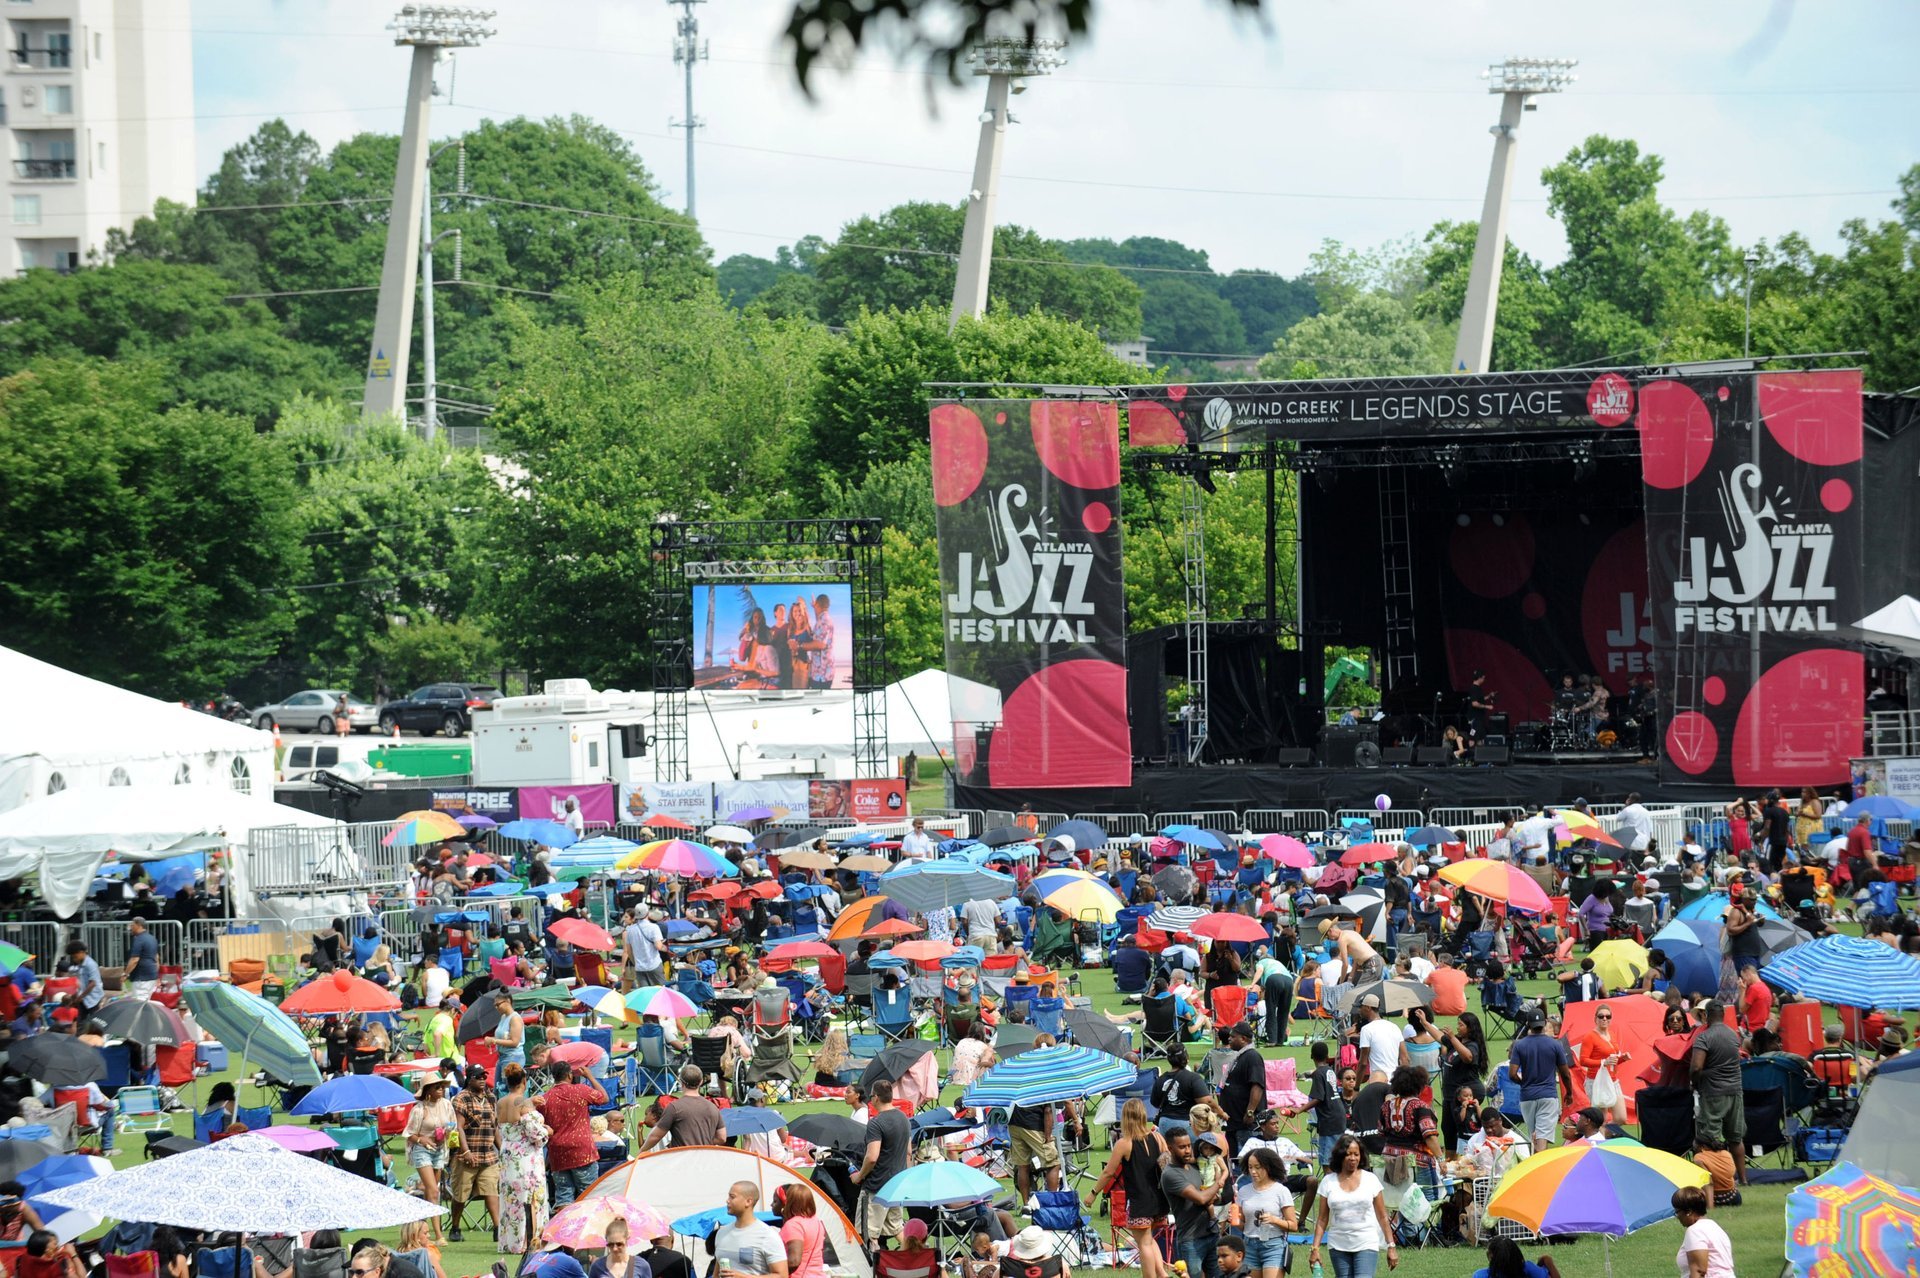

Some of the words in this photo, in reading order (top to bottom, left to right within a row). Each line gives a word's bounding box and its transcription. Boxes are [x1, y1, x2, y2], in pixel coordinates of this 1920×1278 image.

[1236, 402, 1282, 416] WIND
[1286, 400, 1340, 415] CREEK
[1350, 394, 1470, 421] LEGENDS
[1477, 391, 1563, 417] STAGE
[1772, 524, 1832, 535] ATLANTA
[1033, 542, 1093, 553] ATLANTA
[1675, 606, 1837, 632] FESTIVAL
[949, 618, 1096, 643] FESTIVAL
[1890, 774, 1909, 782] FREE
[660, 789, 674, 798] EAT
[677, 789, 703, 797] LOCAL
[439, 792, 466, 800] MONTHS
[466, 791, 512, 809] FREE.
[657, 799, 677, 807] STAY
[854, 794, 880, 806] Coke
